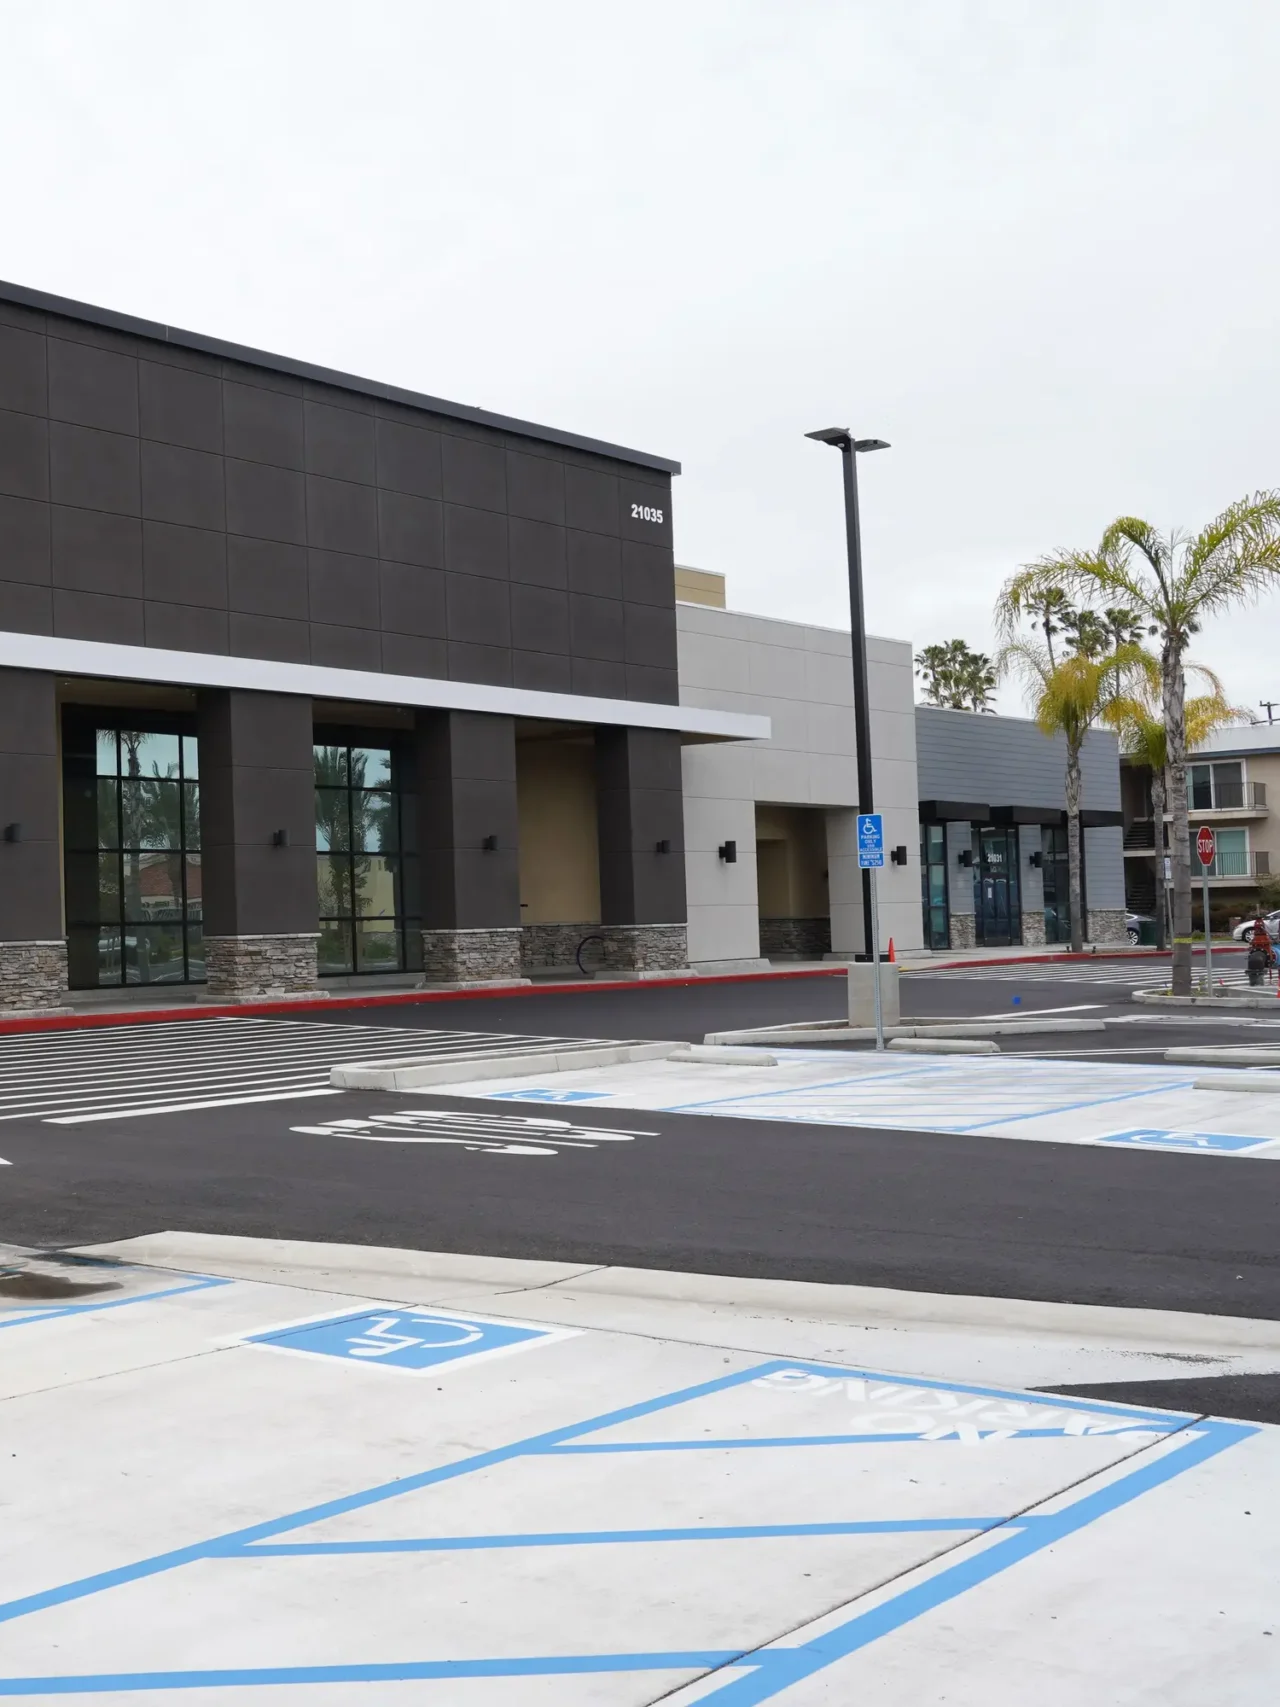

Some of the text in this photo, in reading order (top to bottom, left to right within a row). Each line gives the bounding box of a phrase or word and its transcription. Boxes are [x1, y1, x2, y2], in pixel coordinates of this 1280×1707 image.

[631, 504, 663, 523] 21035
[1198, 839, 1213, 853] STOP
[289, 1110, 661, 1156] STOP
[751, 1368, 1208, 1444] PARKING
[851, 1412, 1019, 1446] NO
